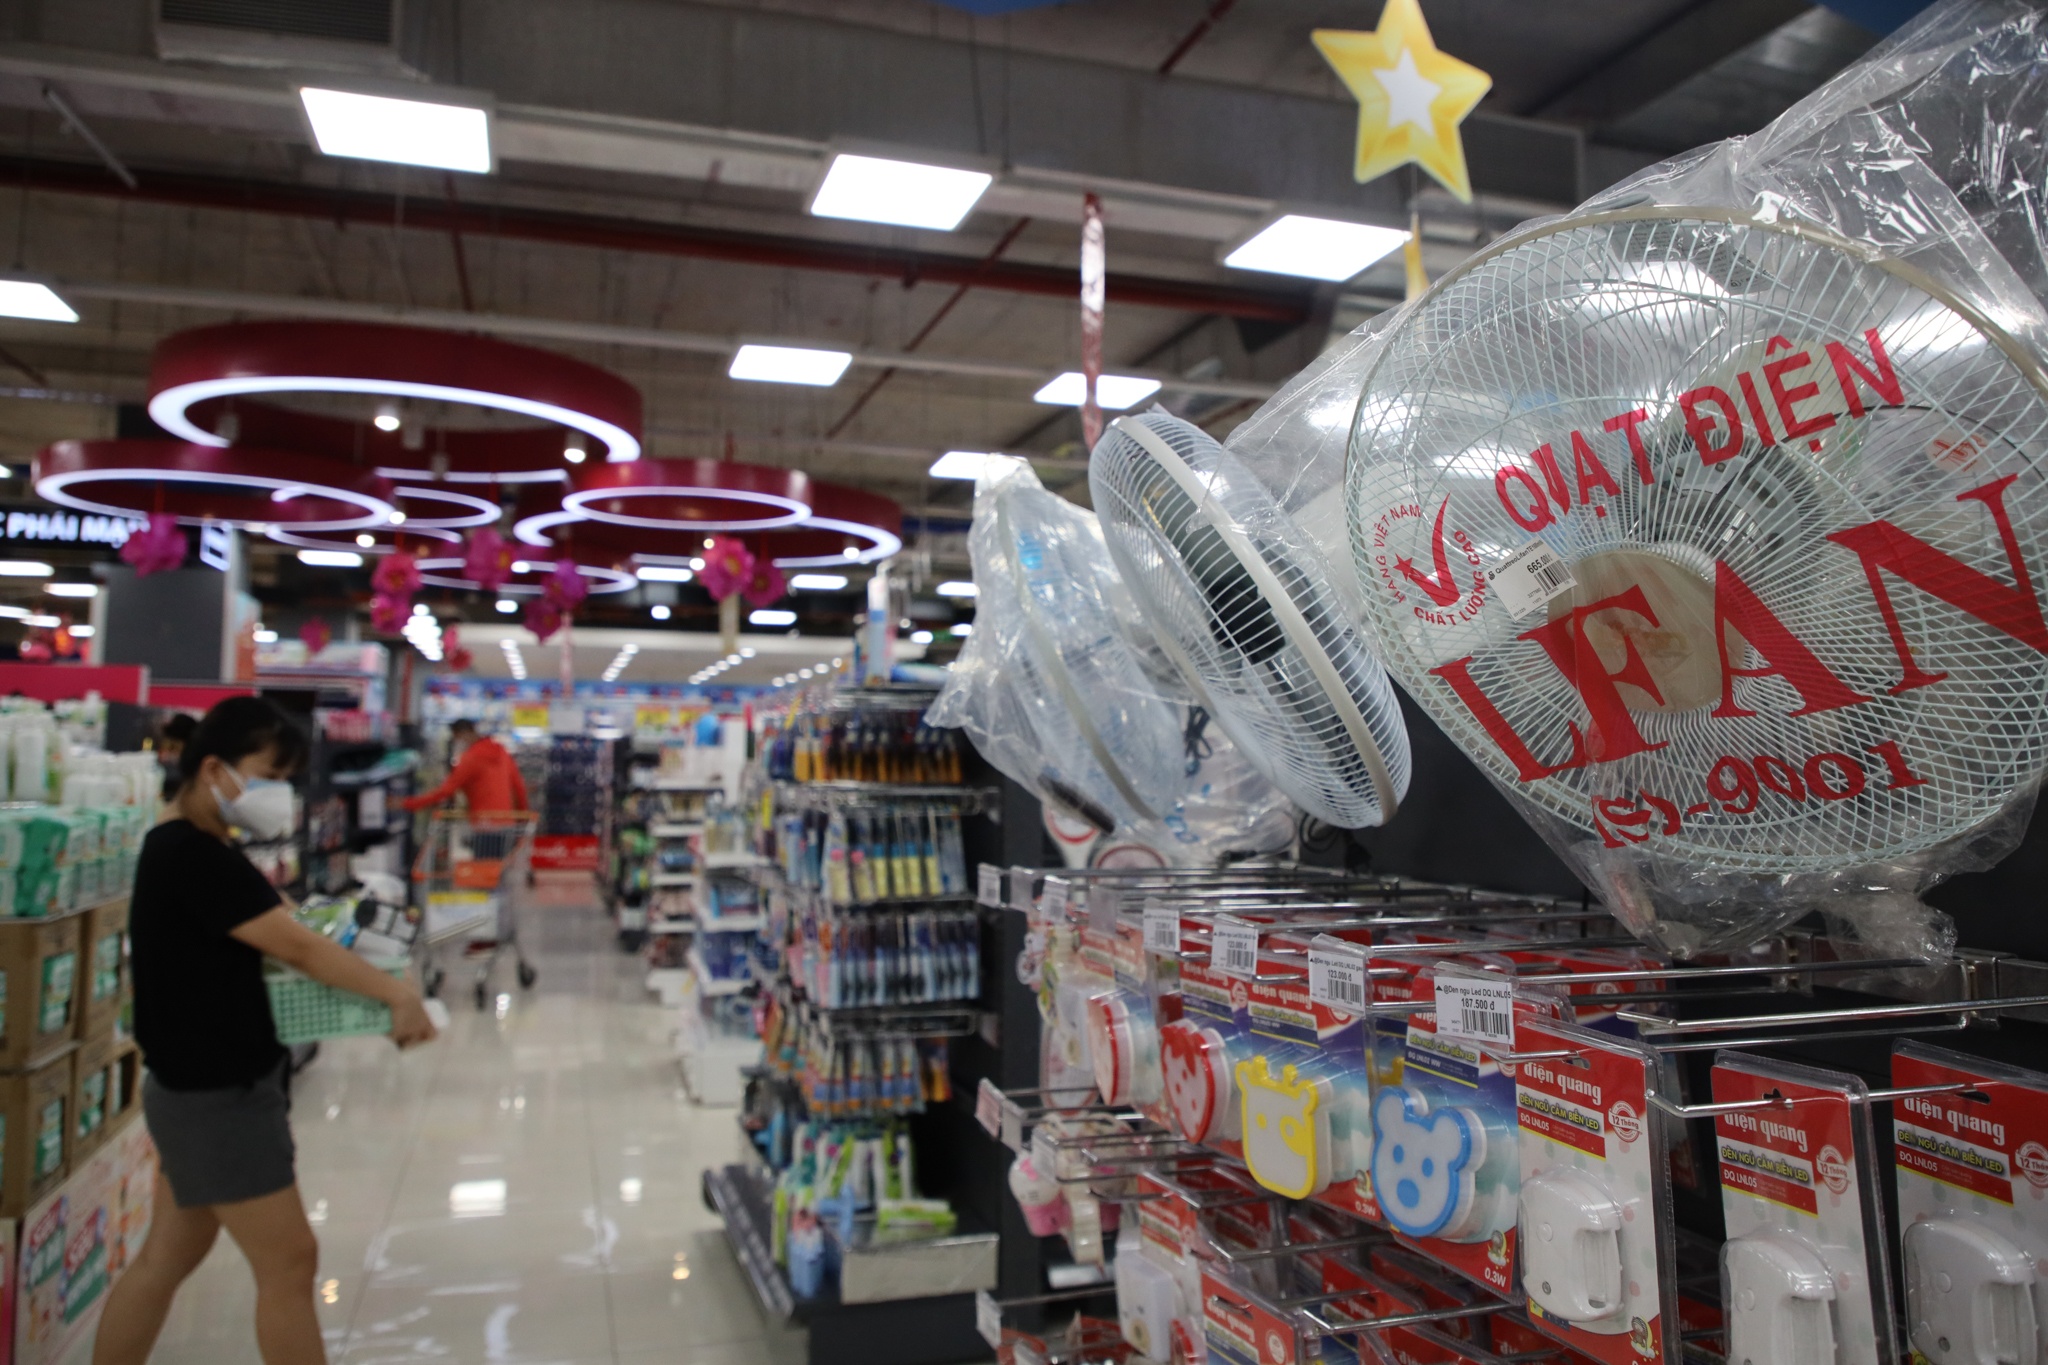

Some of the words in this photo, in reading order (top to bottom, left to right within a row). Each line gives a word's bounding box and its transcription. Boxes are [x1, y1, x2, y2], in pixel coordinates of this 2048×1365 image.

[1495, 408, 1655, 532] QUẠT
[1678, 327, 1905, 466] ĐIỆN
[1390, 504, 1421, 521] NAM
[1453, 530, 1481, 566] CAO
[1328, 969, 1347, 981] 123.000
[1443, 985, 1459, 994] @Den
[1460, 987, 1470, 997] ngu
[1471, 988, 1481, 997] Led
[1483, 989, 1492, 997] DQ
[1492, 990, 1511, 999] LNL05
[1461, 998, 1488, 1010] 187.500
[1490, 1001, 1495, 1010] đ
[1524, 1062, 1554, 1083] điện
[1557, 1073, 1602, 1106] quang
[1520, 1112, 1530, 1125] ĐQ
[1531, 1117, 1550, 1132] LNL05
[1551, 1103, 1567, 1119] CẢM
[1586, 1118, 1599, 1130] LED
[1611, 1115, 1620, 1125] 12
[1621, 1118, 1639, 1130] Tháng
[1760, 1118, 1808, 1153] quang
[1947, 1109, 2005, 1146] quang
[1899, 1151, 1913, 1164] ĐQ
[1914, 1155, 1938, 1172] LNL05
[1918, 1135, 1937, 1151] NGỦ
[1939, 1141, 1959, 1159] CẢM
[1985, 1158, 2003, 1173] LED
[2020, 1156, 2030, 1169] 12
[1739, 1150, 1755, 1166] NGỦ
[1757, 1153, 1774, 1171] CẢM
[1795, 1168, 1809, 1182] LED
[1820, 1161, 1829, 1174] 12
[1724, 1169, 1735, 1183] ĐQ
[1736, 1173, 1758, 1188] LNL05
[1485, 1267, 1506, 1288] 0.3W
